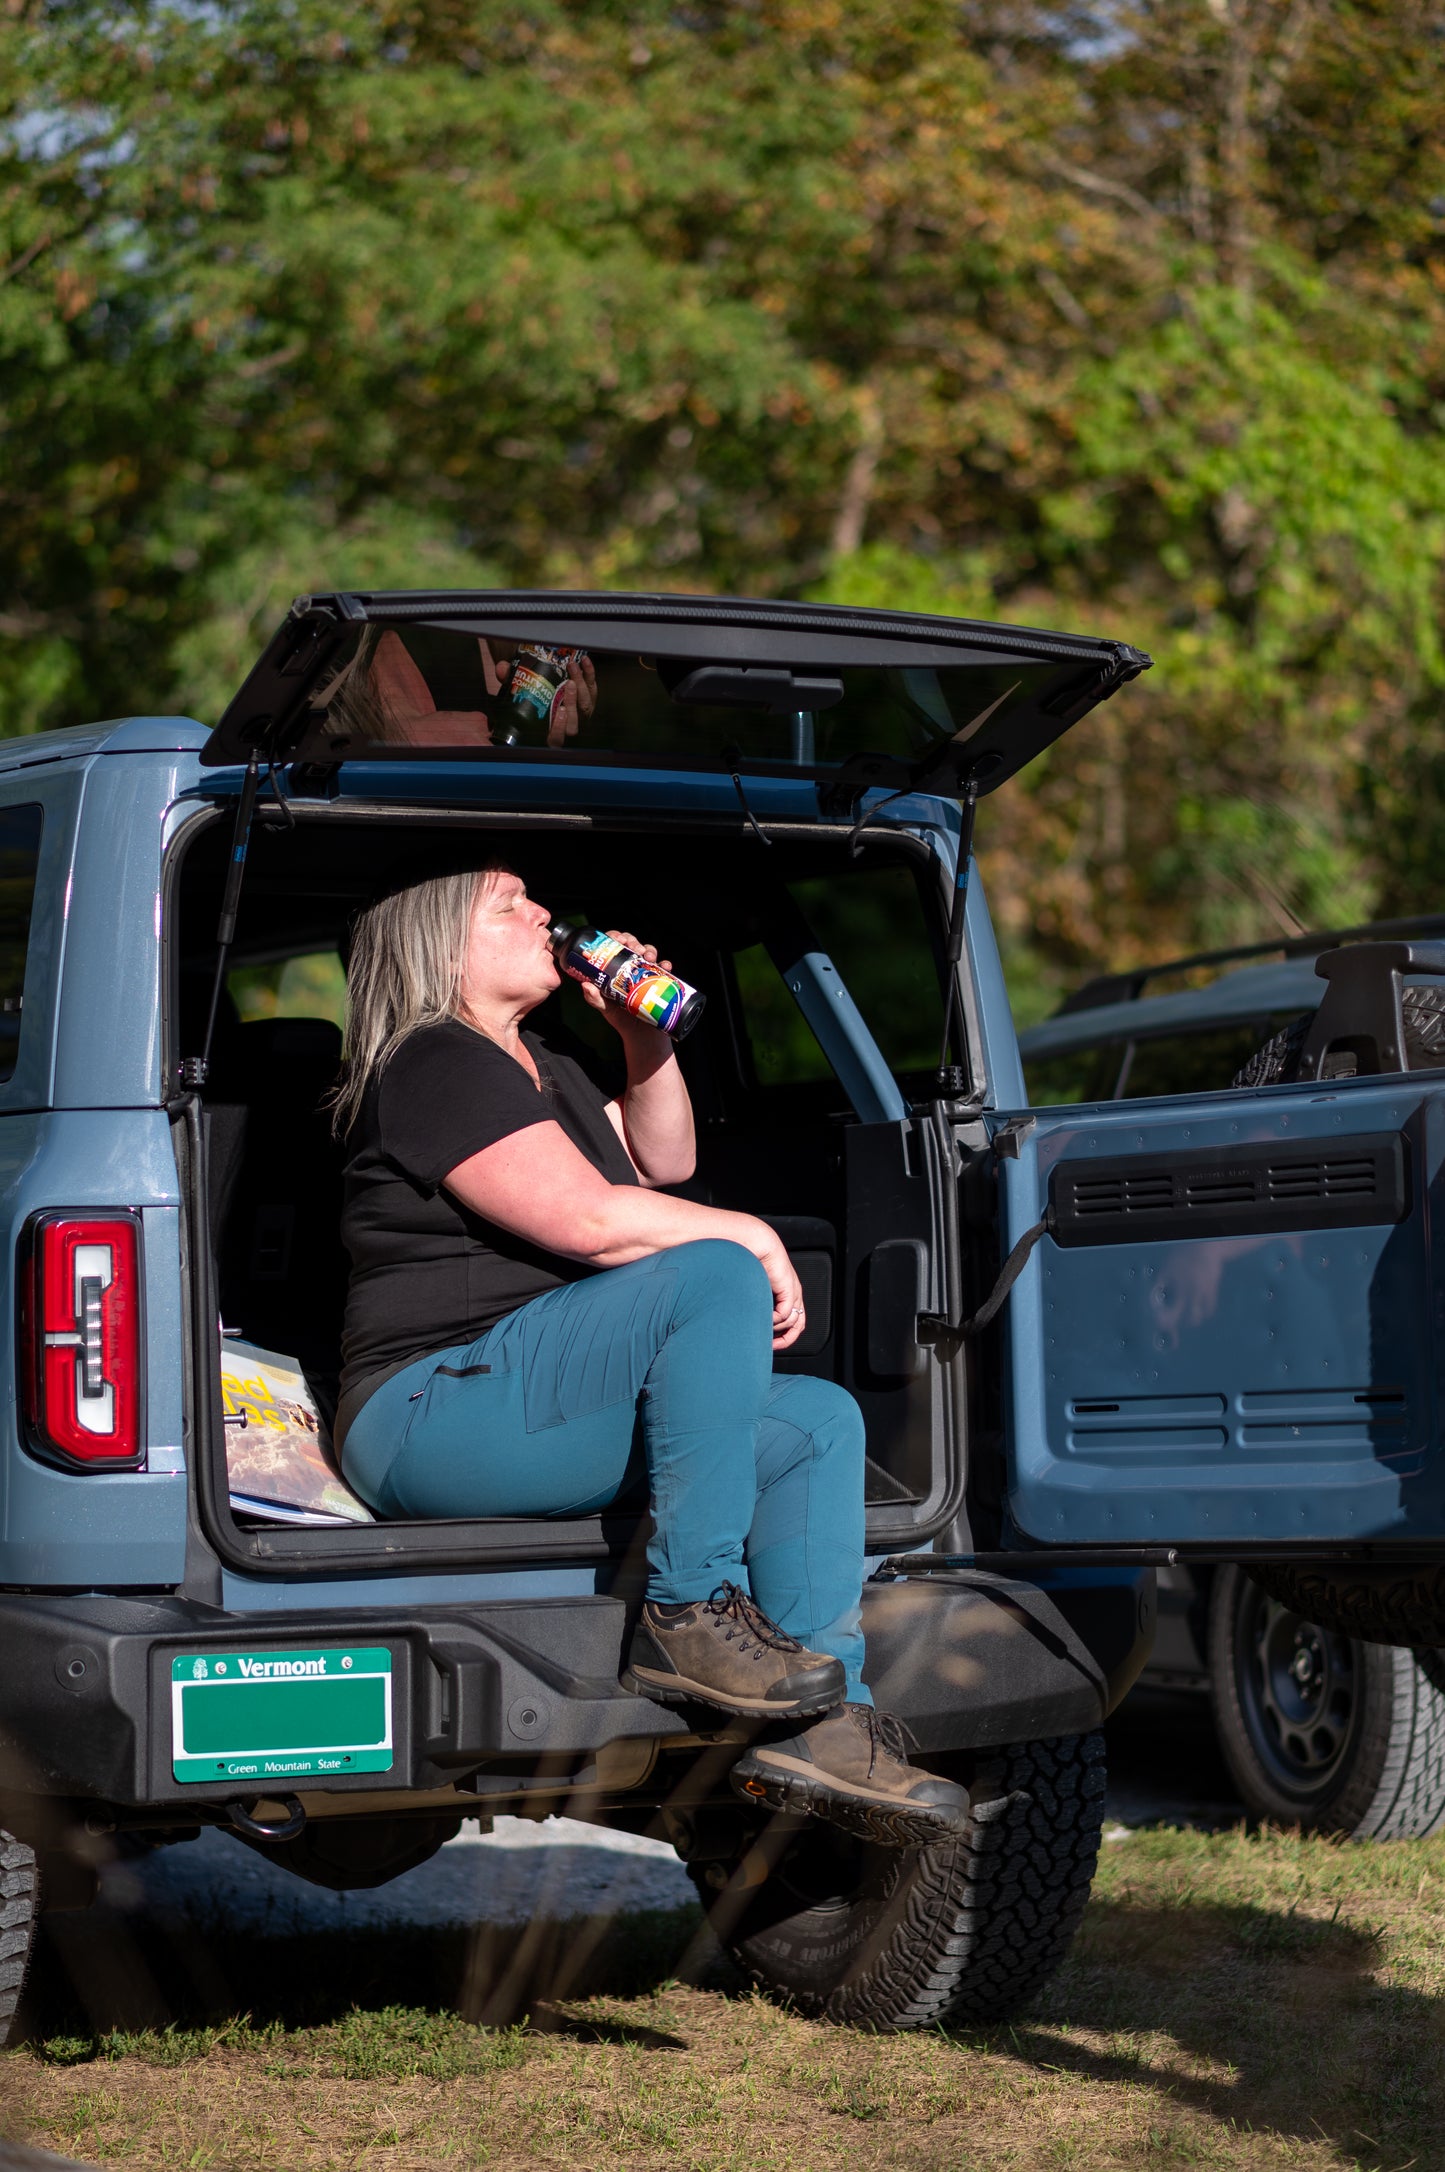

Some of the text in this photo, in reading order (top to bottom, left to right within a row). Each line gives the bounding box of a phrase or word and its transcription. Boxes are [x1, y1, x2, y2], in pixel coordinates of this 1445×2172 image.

[593, 940, 618, 968] RUTLAN
[594, 972, 607, 988] List
[221, 1372, 275, 1405] ad
[223, 1391, 286, 1431] las
[238, 1657, 327, 1677] Vermont
[228, 1758, 341, 1775] Green Mountain State
